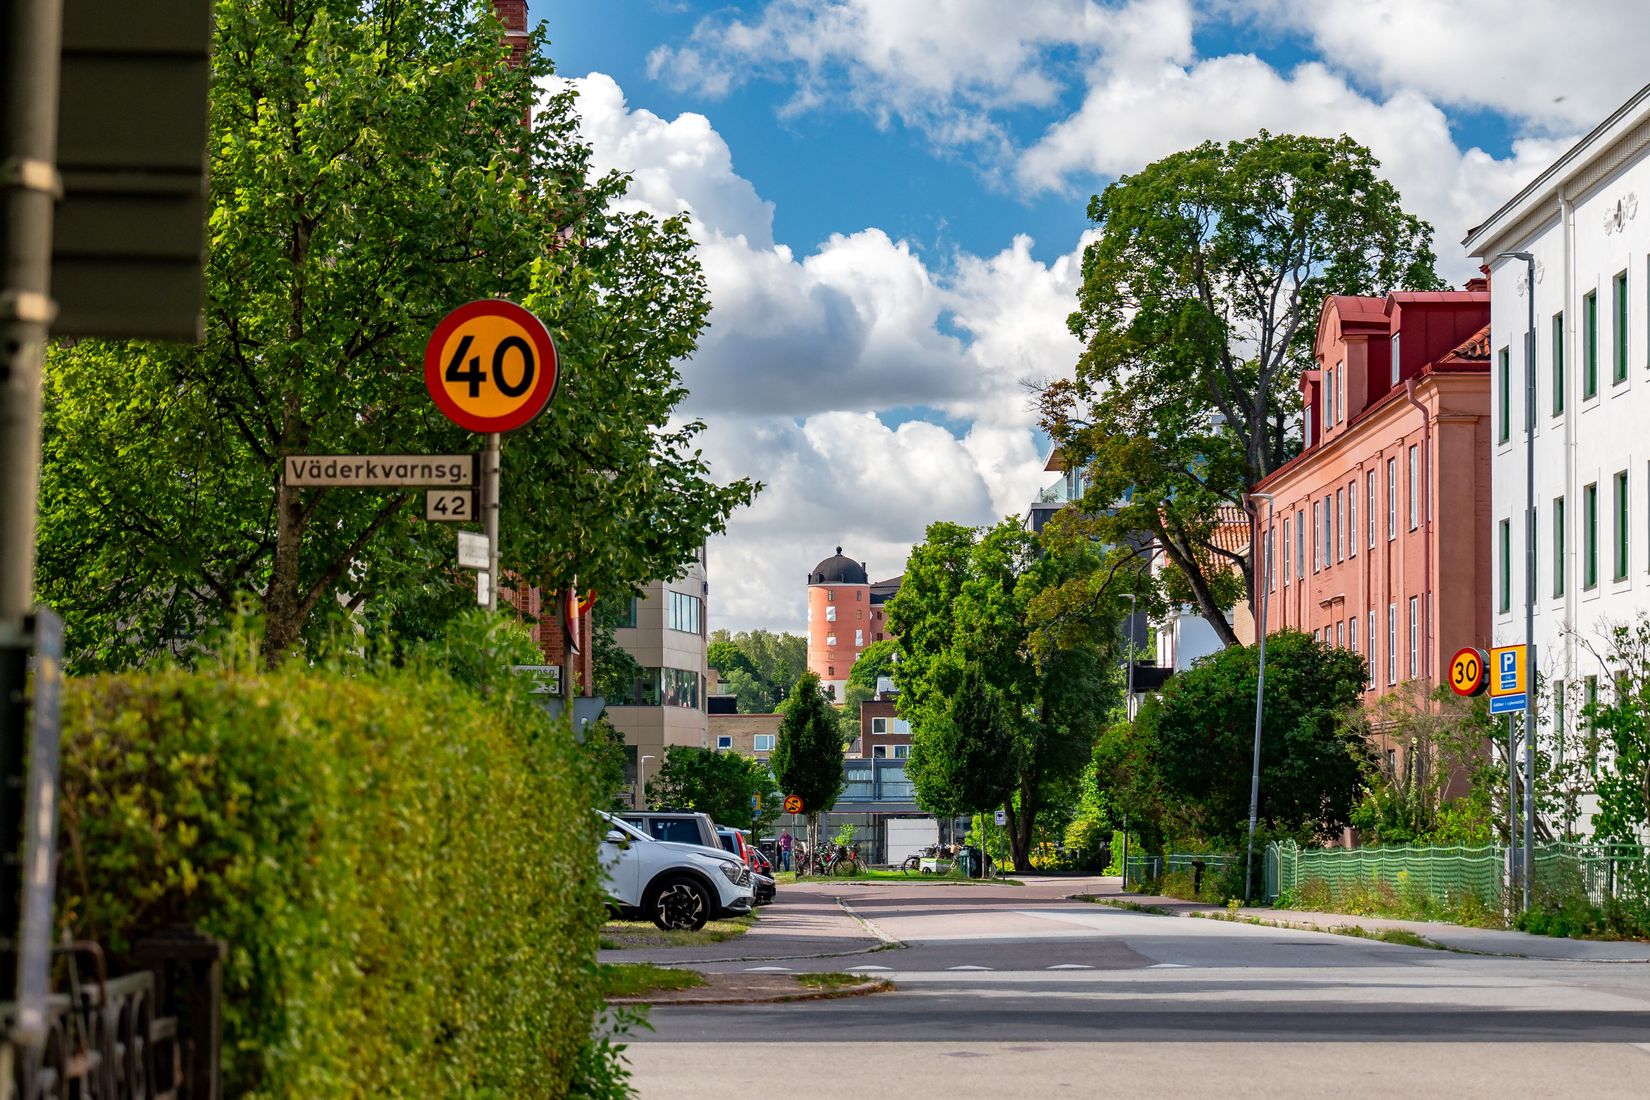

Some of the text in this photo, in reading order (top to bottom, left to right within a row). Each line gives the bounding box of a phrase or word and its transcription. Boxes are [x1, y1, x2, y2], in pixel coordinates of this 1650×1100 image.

[446, 335, 535, 398] 40
[291, 460, 467, 483] Väderkvarnsg.
[433, 496, 466, 516] 42
[1455, 659, 1477, 684] 30
[1504, 653, 1514, 672] P
